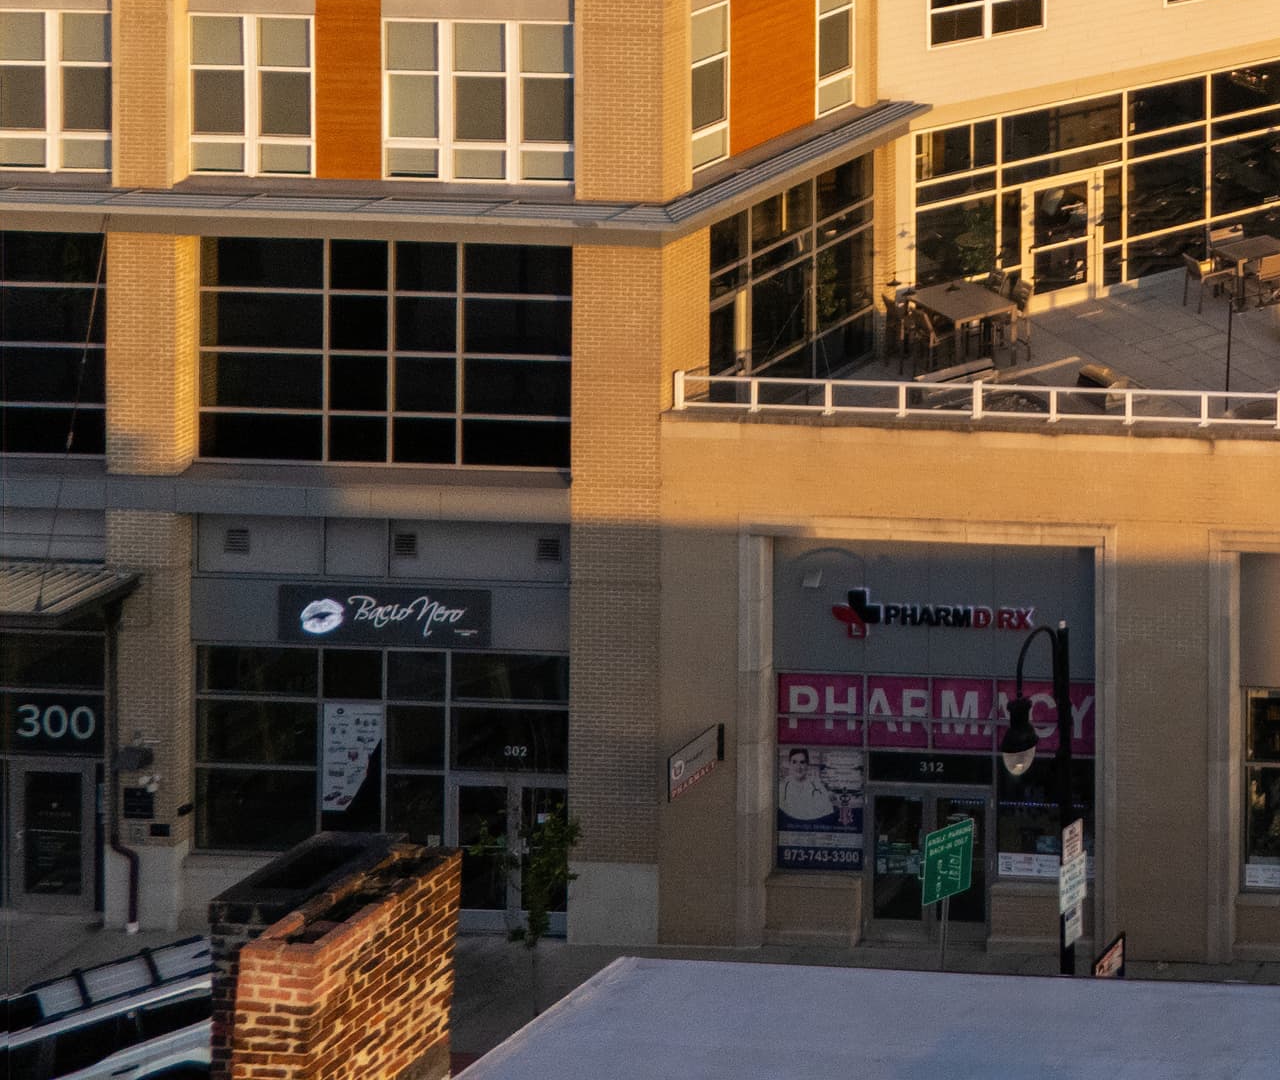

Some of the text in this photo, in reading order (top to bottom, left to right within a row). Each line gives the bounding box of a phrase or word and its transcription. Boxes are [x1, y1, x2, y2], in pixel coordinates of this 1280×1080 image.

[408, 596, 467, 637] Nero
[996, 606, 1036, 630] RX
[16, 703, 96, 740] 300
[788, 684, 1095, 740] PHARMACY
[504, 745, 528, 758] 302
[920, 760, 945, 773] 312
[784, 849, 860, 863] 973-743-3300
